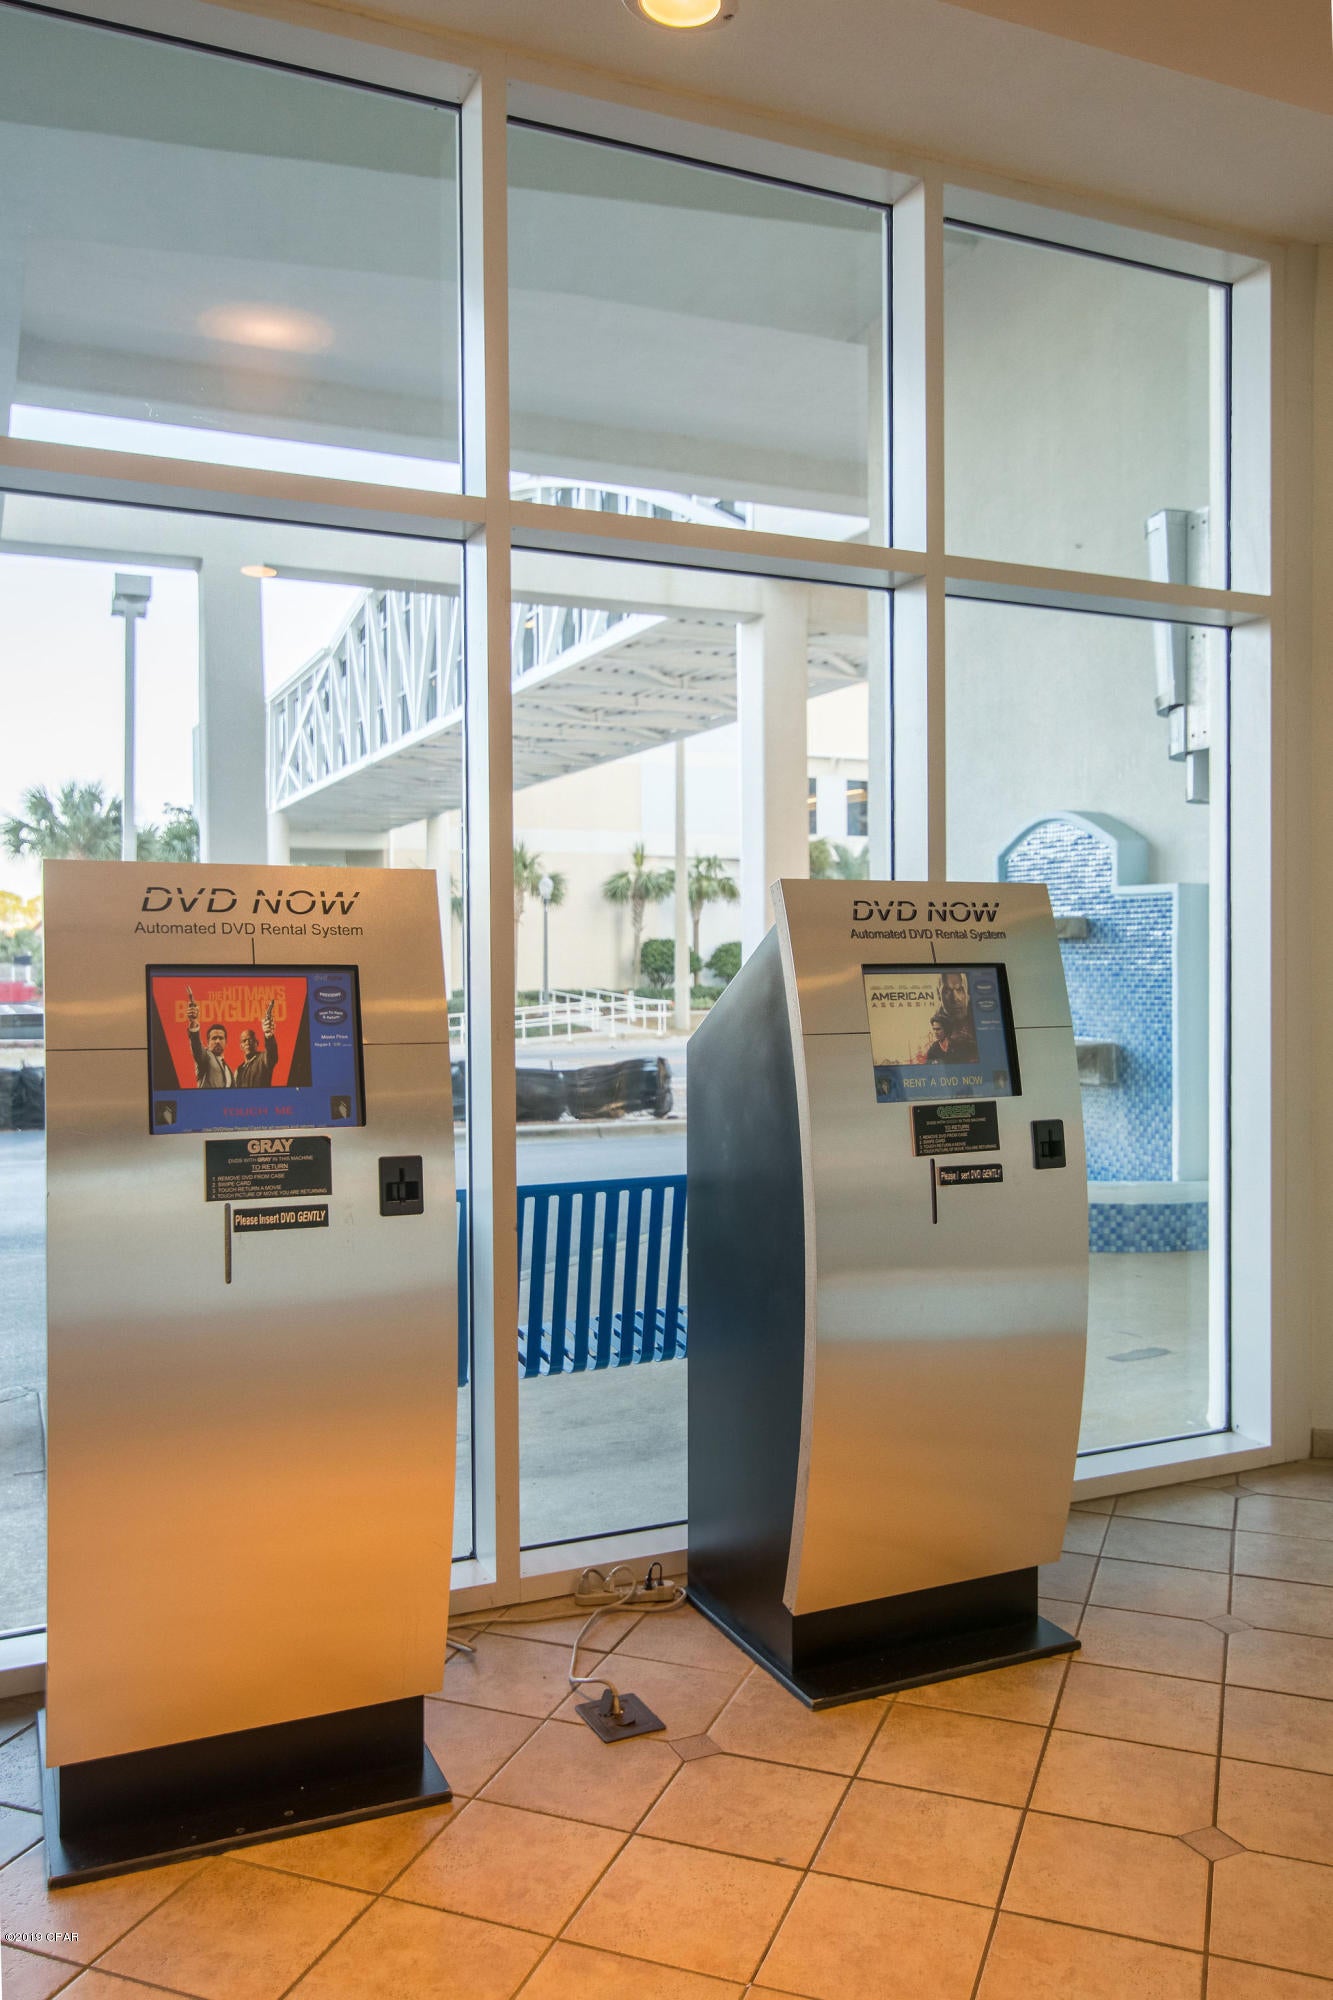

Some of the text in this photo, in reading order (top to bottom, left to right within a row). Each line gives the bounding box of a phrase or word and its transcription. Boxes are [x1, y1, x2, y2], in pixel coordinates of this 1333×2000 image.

[141, 886, 360, 915] DVD NOW
[853, 900, 999, 922] DVD NOW
[134, 921, 364, 938] Automated DVD Rental System
[850, 928, 1006, 942] Automated DVD Rental System
[223, 985, 286, 1000] HITMAN'S
[871, 992, 935, 1001] AMERICAN
[174, 1000, 287, 1023] BDYGUAD
[903, 1076, 983, 1088] RENT A DVD NOW
[223, 1106, 294, 1117] TOUCH ME
[248, 1138, 294, 1154] GRAY
[235, 1210, 326, 1226] Please Insert DVD GENTLY
